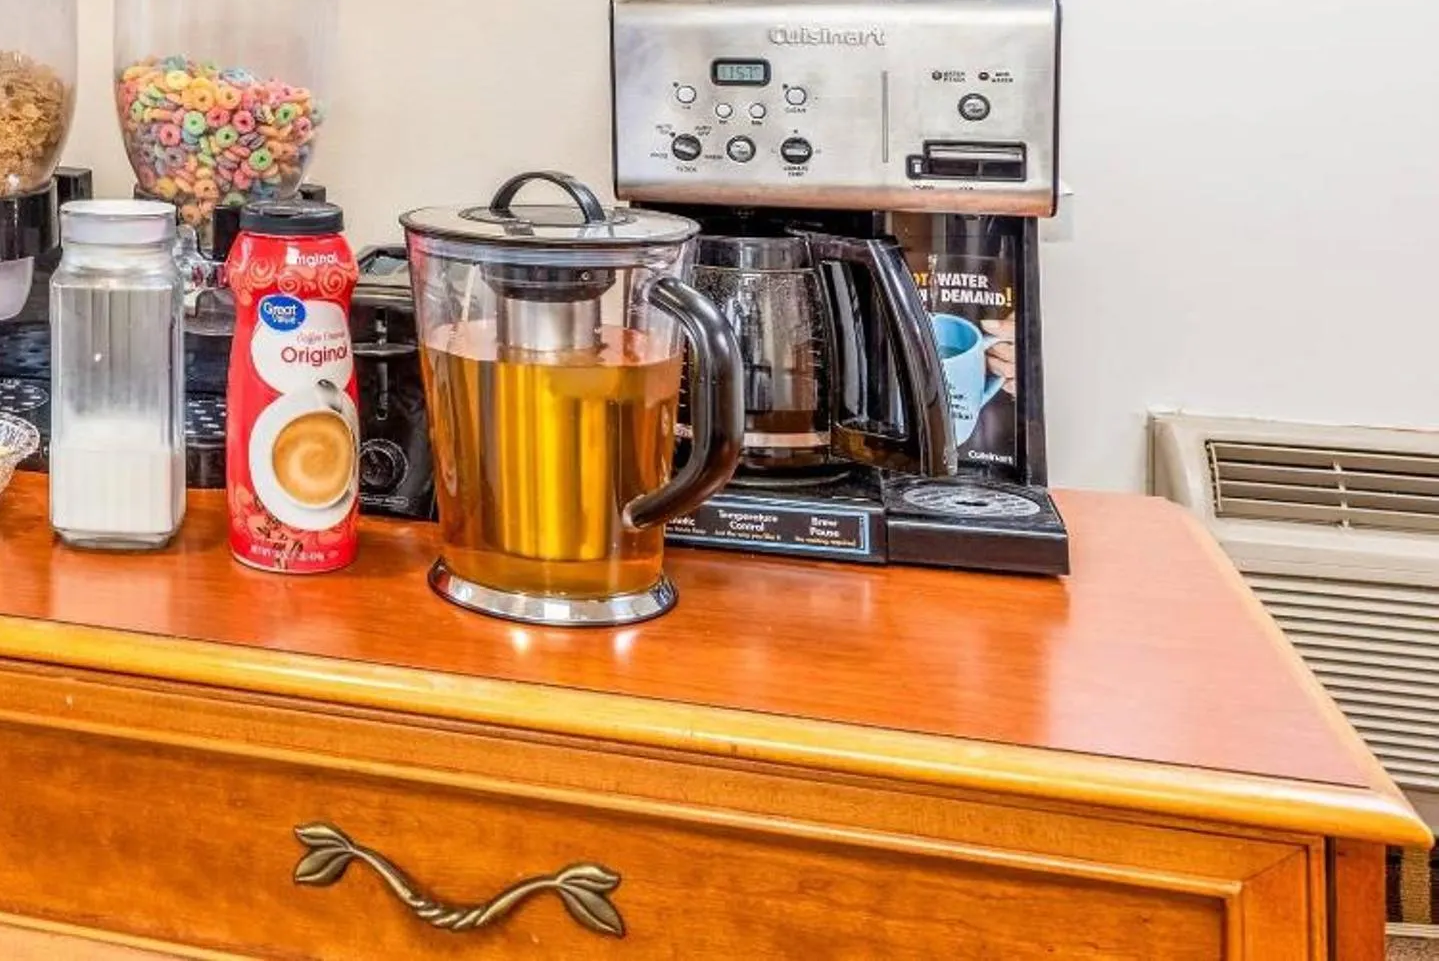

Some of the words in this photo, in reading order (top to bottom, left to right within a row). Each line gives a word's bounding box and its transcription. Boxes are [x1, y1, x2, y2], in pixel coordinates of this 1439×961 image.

[768, 26, 887, 47] Cuisinart
[937, 273, 989, 288] WATER
[263, 301, 297, 315] Great
[941, 287, 1013, 308] DEMAND!
[281, 346, 348, 367] Original
